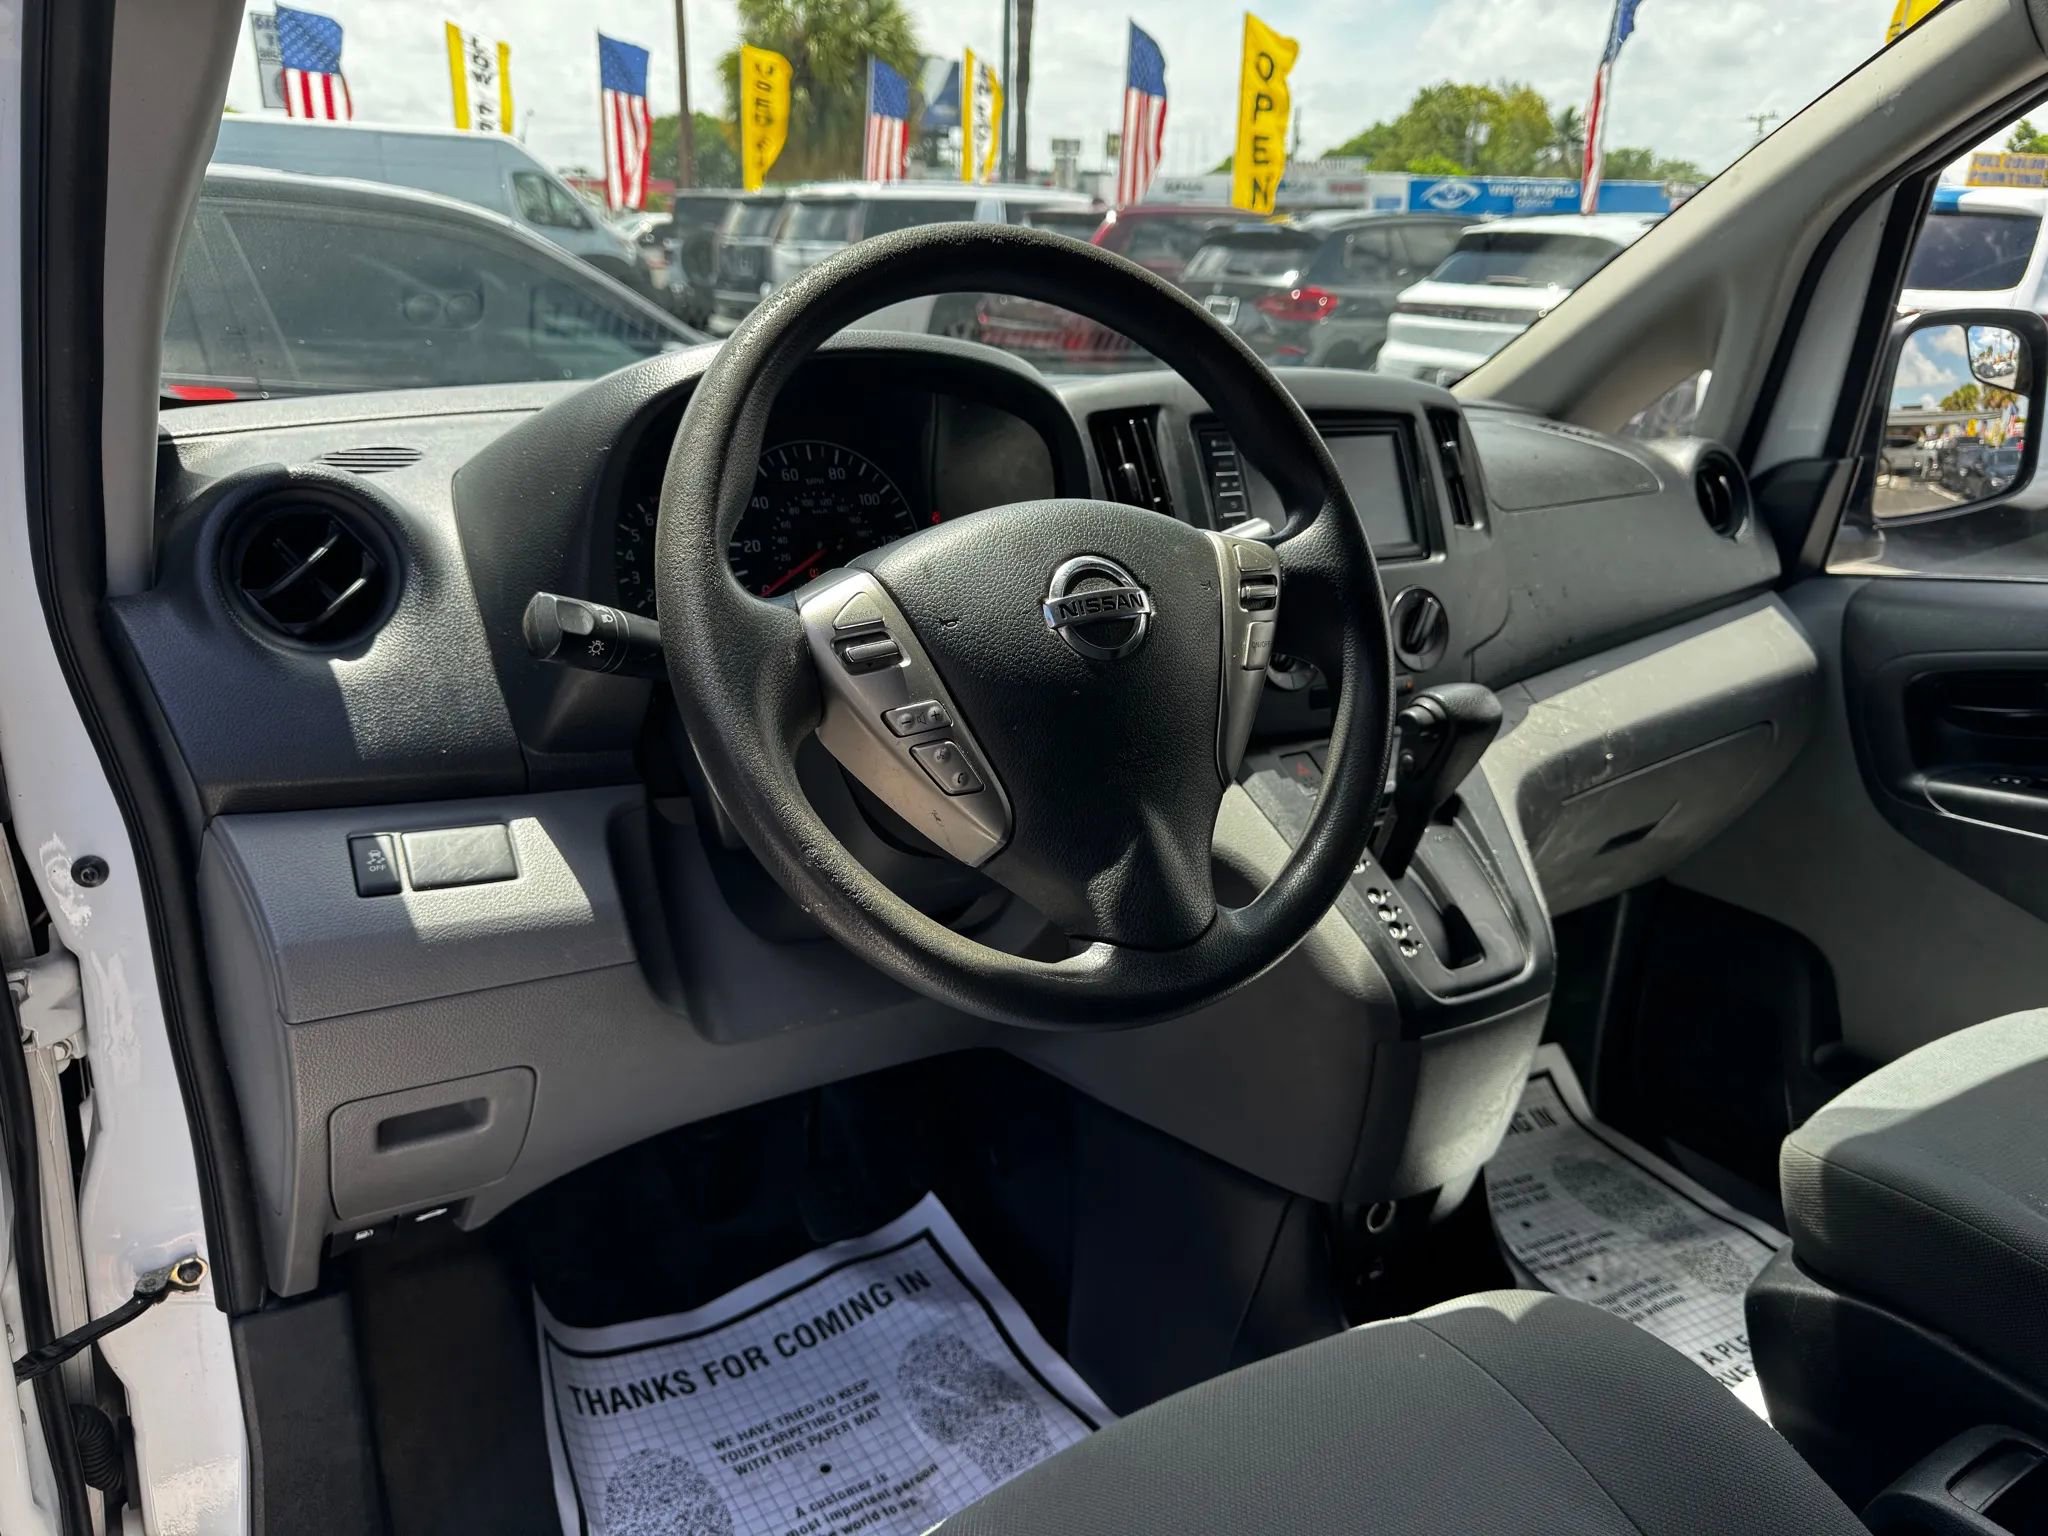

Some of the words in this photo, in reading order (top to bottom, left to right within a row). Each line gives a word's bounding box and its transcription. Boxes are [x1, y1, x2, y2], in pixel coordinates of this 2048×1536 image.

[1252, 51, 1274, 209] OPEN
[781, 468, 799, 482] 60
[828, 467, 846, 480] 80
[751, 496, 769, 510] 40
[859, 493, 880, 506] 100
[644, 513, 654, 526] 6
[631, 529, 640, 542] 5
[744, 539, 761, 553] 20
[625, 549, 635, 562] 4
[631, 571, 640, 584] 3
[1058, 593, 1145, 620] NISSAN
[369, 864, 386, 872] OFF
[568, 1368, 697, 1416] THANKS
[702, 1345, 770, 1386] FOR
[774, 1282, 895, 1357] COMING
[895, 1270, 931, 1295] IN
[1701, 1350, 1723, 1366] A
[712, 1436, 732, 1450] WE
[737, 1419, 773, 1442] HAVE
[776, 1403, 816, 1426] TRIED
[817, 1394, 836, 1408] TO
[838, 1378, 869, 1400] KEEP
[718, 1444, 758, 1464] YOUR
[761, 1410, 836, 1449] CARPETING
[838, 1391, 881, 1416] CLEAN
[733, 1456, 771, 1476] WITH
[775, 1440, 806, 1460] THIS
[808, 1420, 850, 1447] PAPER
[853, 1406, 881, 1426] MAT
[785, 1518, 821, 1536] most
[824, 1489, 891, 1523] important
[893, 1463, 939, 1497] person
[795, 1506, 806, 1518] A
[809, 1479, 872, 1513] customer
[875, 1472, 889, 1484] is
[841, 1511, 881, 1535] world
[882, 1506, 898, 1517] to
[900, 1498, 918, 1510] us
